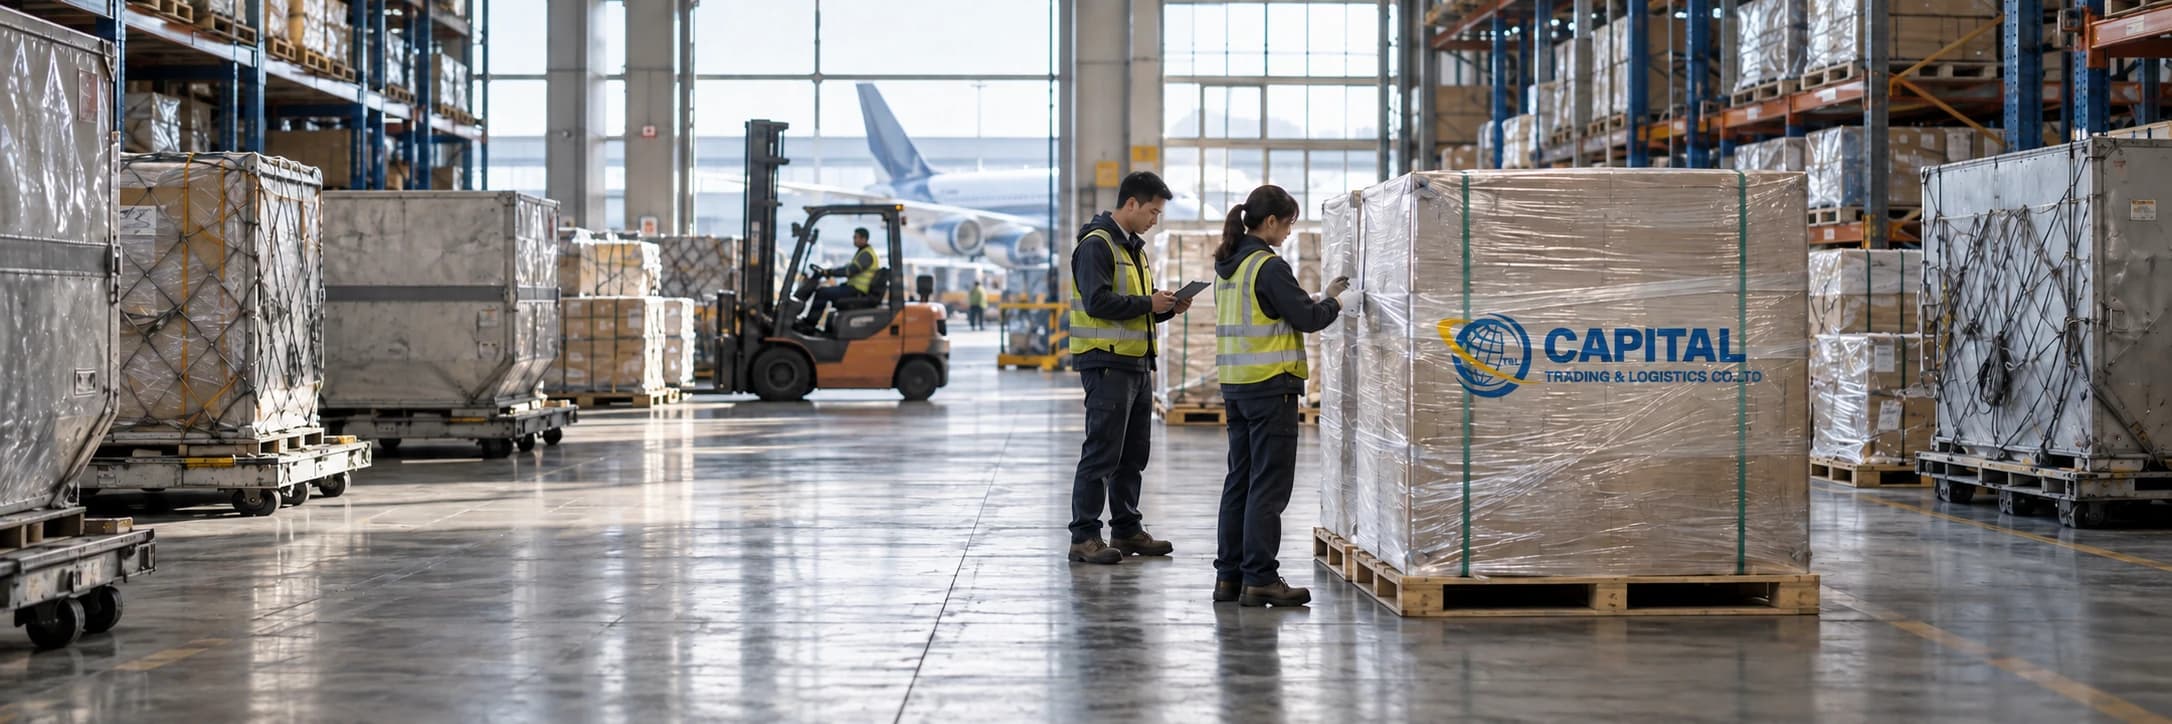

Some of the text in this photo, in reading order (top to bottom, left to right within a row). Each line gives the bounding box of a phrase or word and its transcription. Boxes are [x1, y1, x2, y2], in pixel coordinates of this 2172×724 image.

[1545, 328, 1746, 362] CAPITAL
[1545, 371, 1609, 382] TRADING
[1615, 371, 1624, 382] &
[1629, 371, 1707, 382] LOGISTICS
